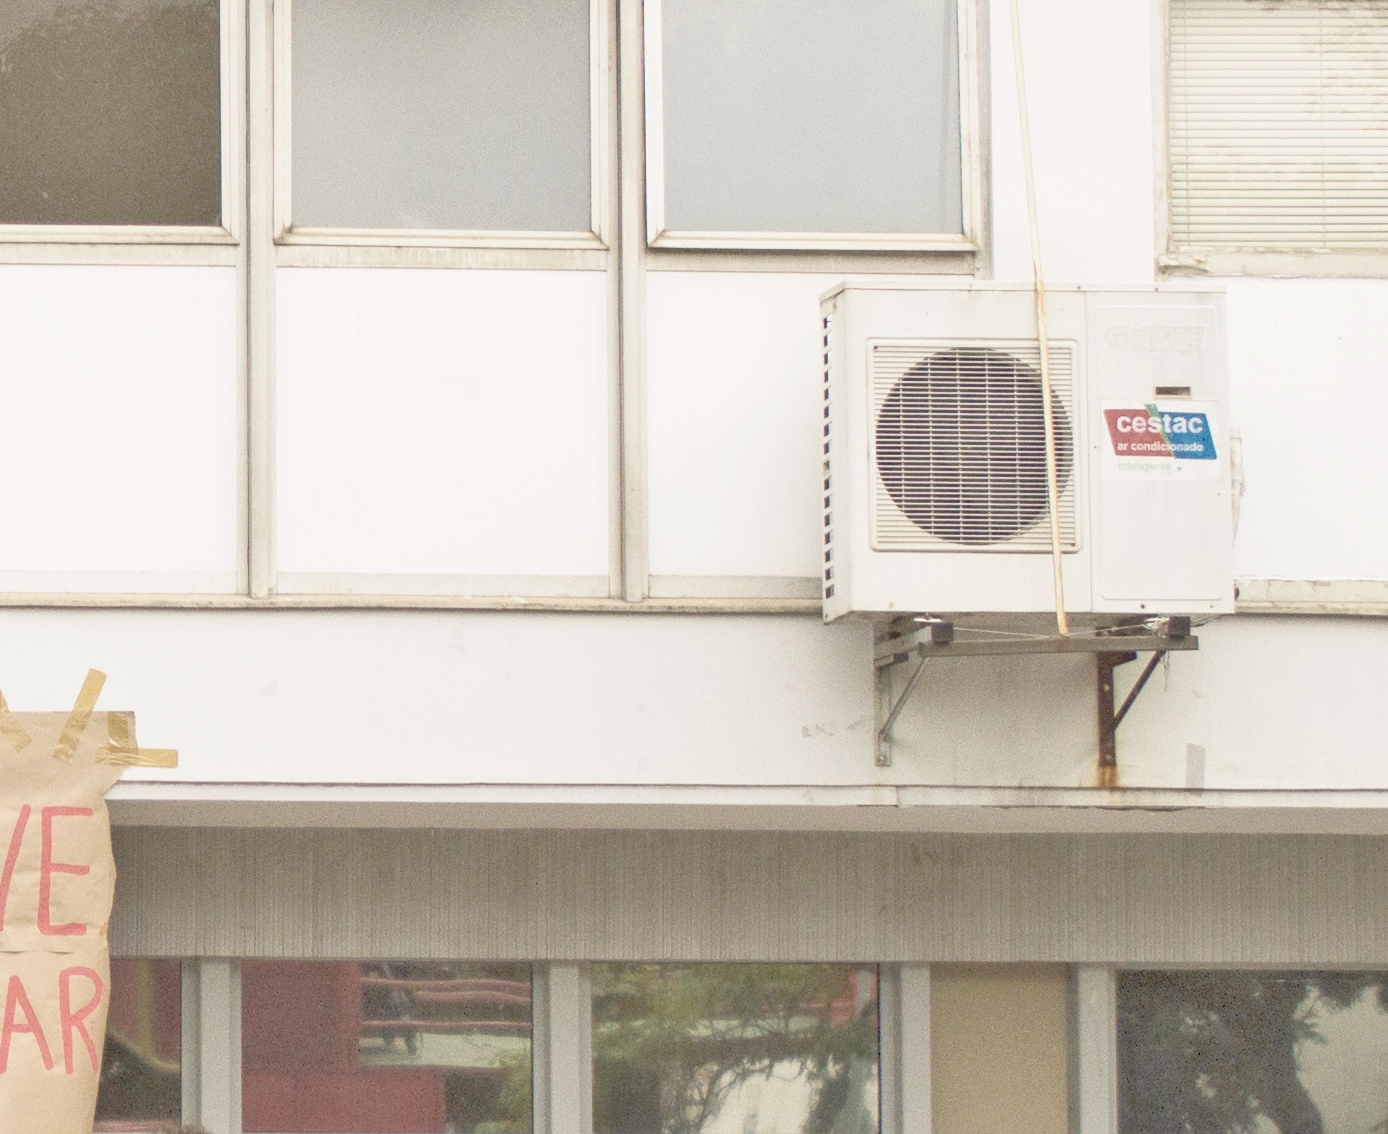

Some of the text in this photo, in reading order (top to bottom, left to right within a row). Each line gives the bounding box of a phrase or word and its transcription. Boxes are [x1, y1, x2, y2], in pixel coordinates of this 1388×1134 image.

[1117, 415, 1203, 433] cestac
[1117, 440, 1204, 452] ar condicionado
